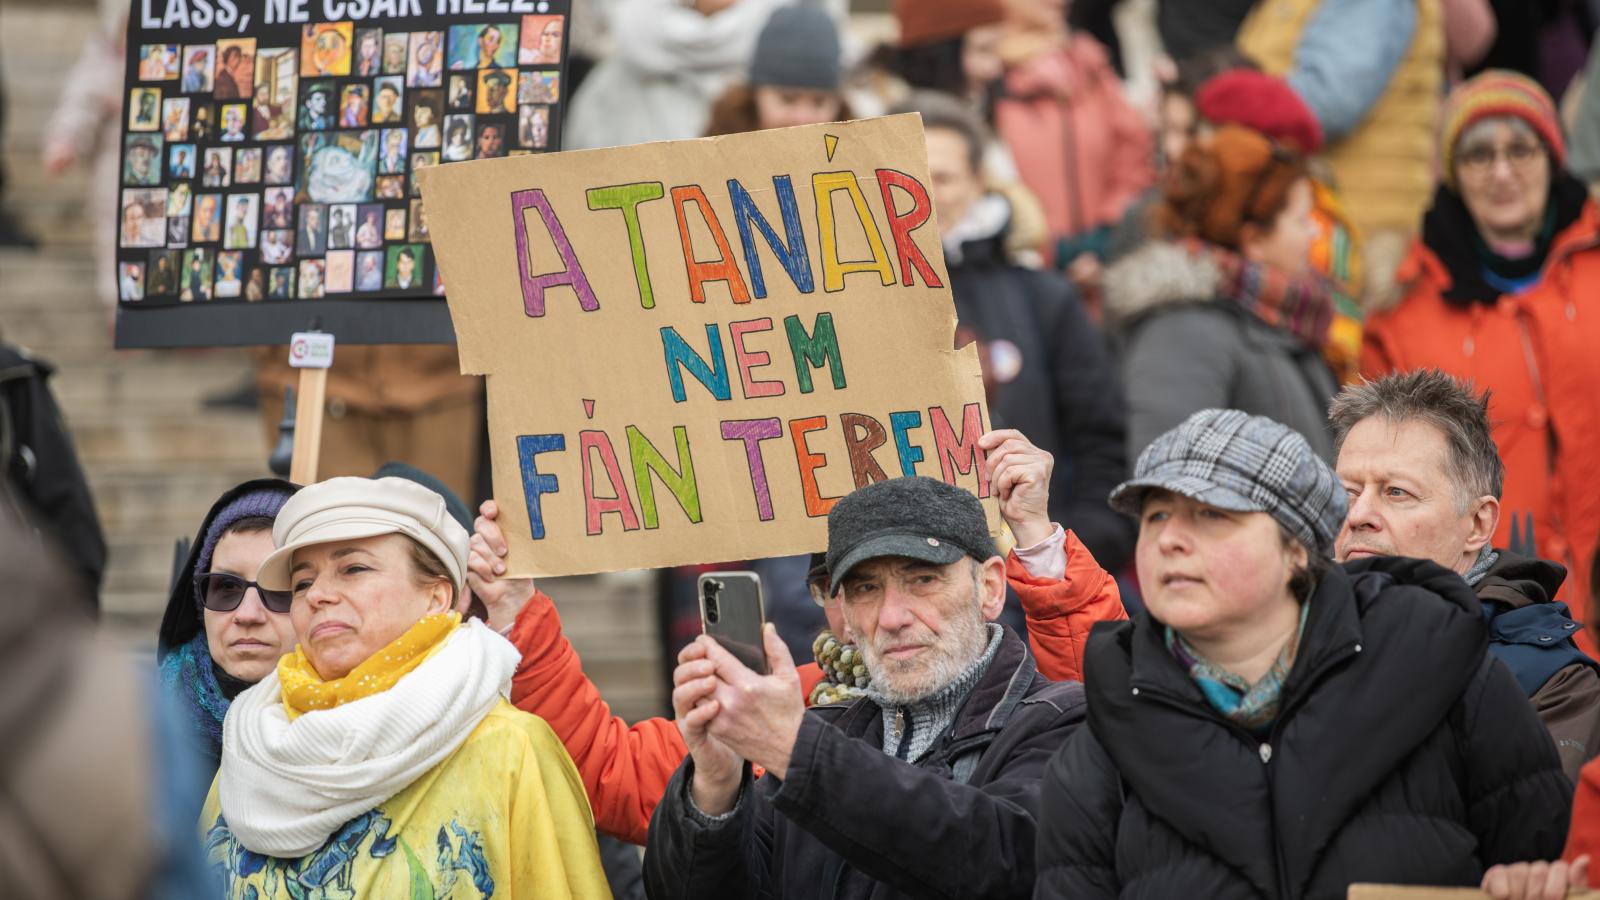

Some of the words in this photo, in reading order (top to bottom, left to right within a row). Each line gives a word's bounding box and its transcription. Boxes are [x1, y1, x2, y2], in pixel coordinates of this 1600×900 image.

[264, 0, 310, 24] NE
[510, 188, 600, 318] A
[585, 134, 944, 310] TANÁR
[660, 312, 847, 403] NEM
[516, 398, 703, 540] FÁN
